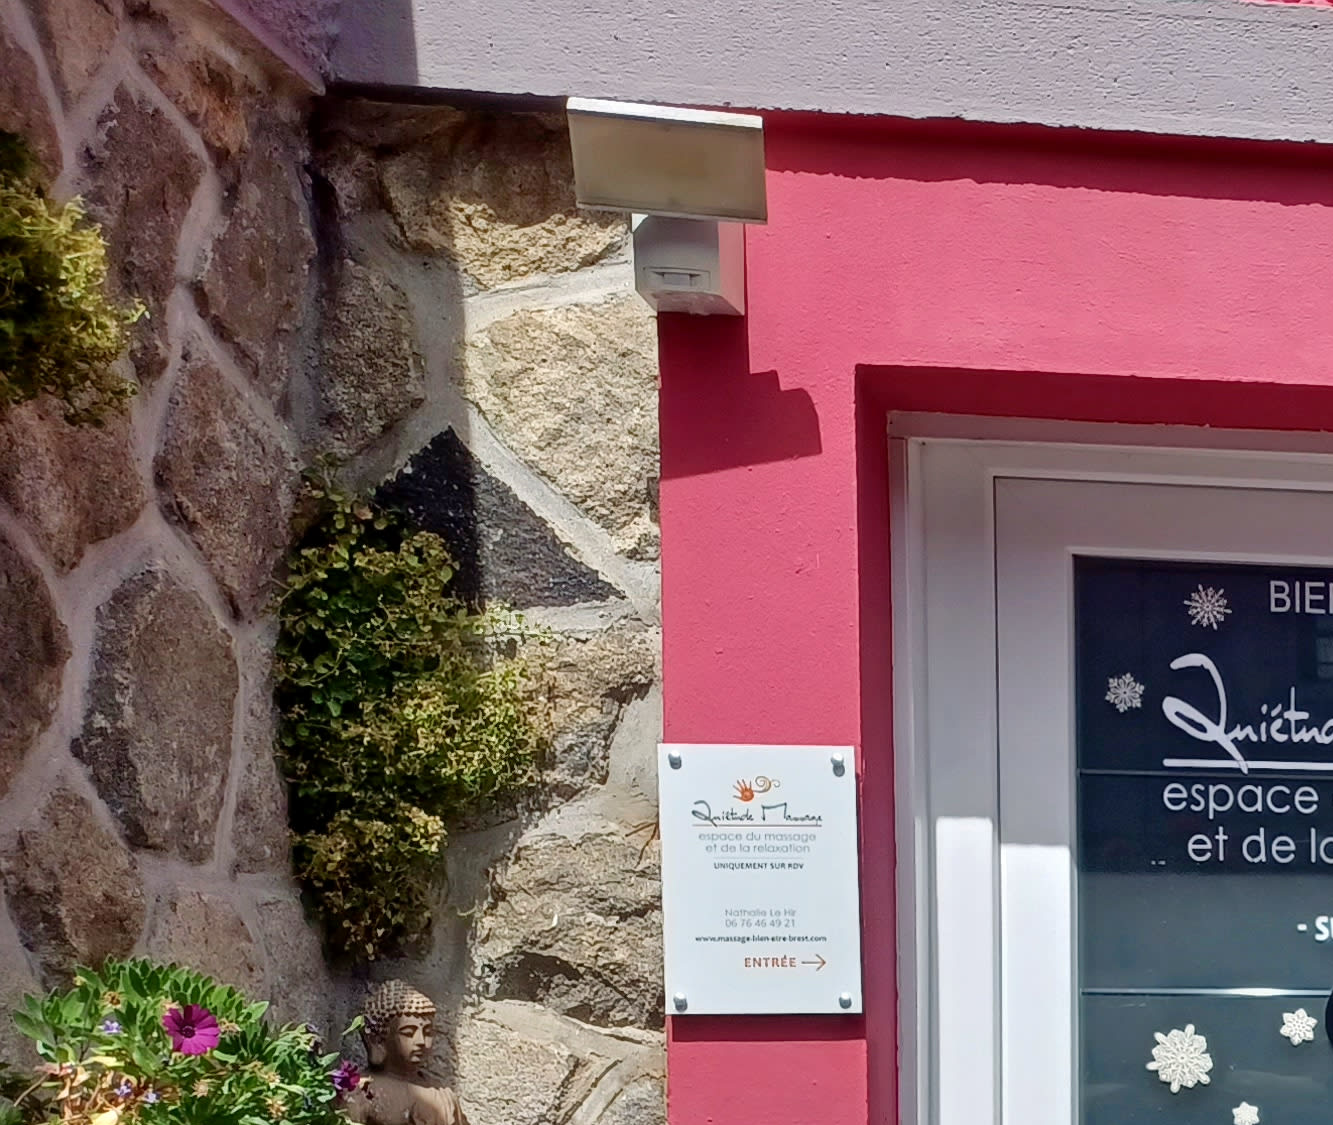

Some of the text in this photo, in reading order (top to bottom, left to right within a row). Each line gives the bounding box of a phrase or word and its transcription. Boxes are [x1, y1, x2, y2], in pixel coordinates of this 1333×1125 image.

[1163, 781, 1319, 820] espace
[698, 831, 816, 843] espace du massage
[705, 843, 811, 854] et de la relaxation
[1187, 826, 1229, 862] et
[1242, 828, 1297, 863] de
[714, 862, 805, 871] UNIQUEMENT SUR RDV
[769, 908, 782, 918] Le
[744, 955, 797, 968] ENTRÉE
